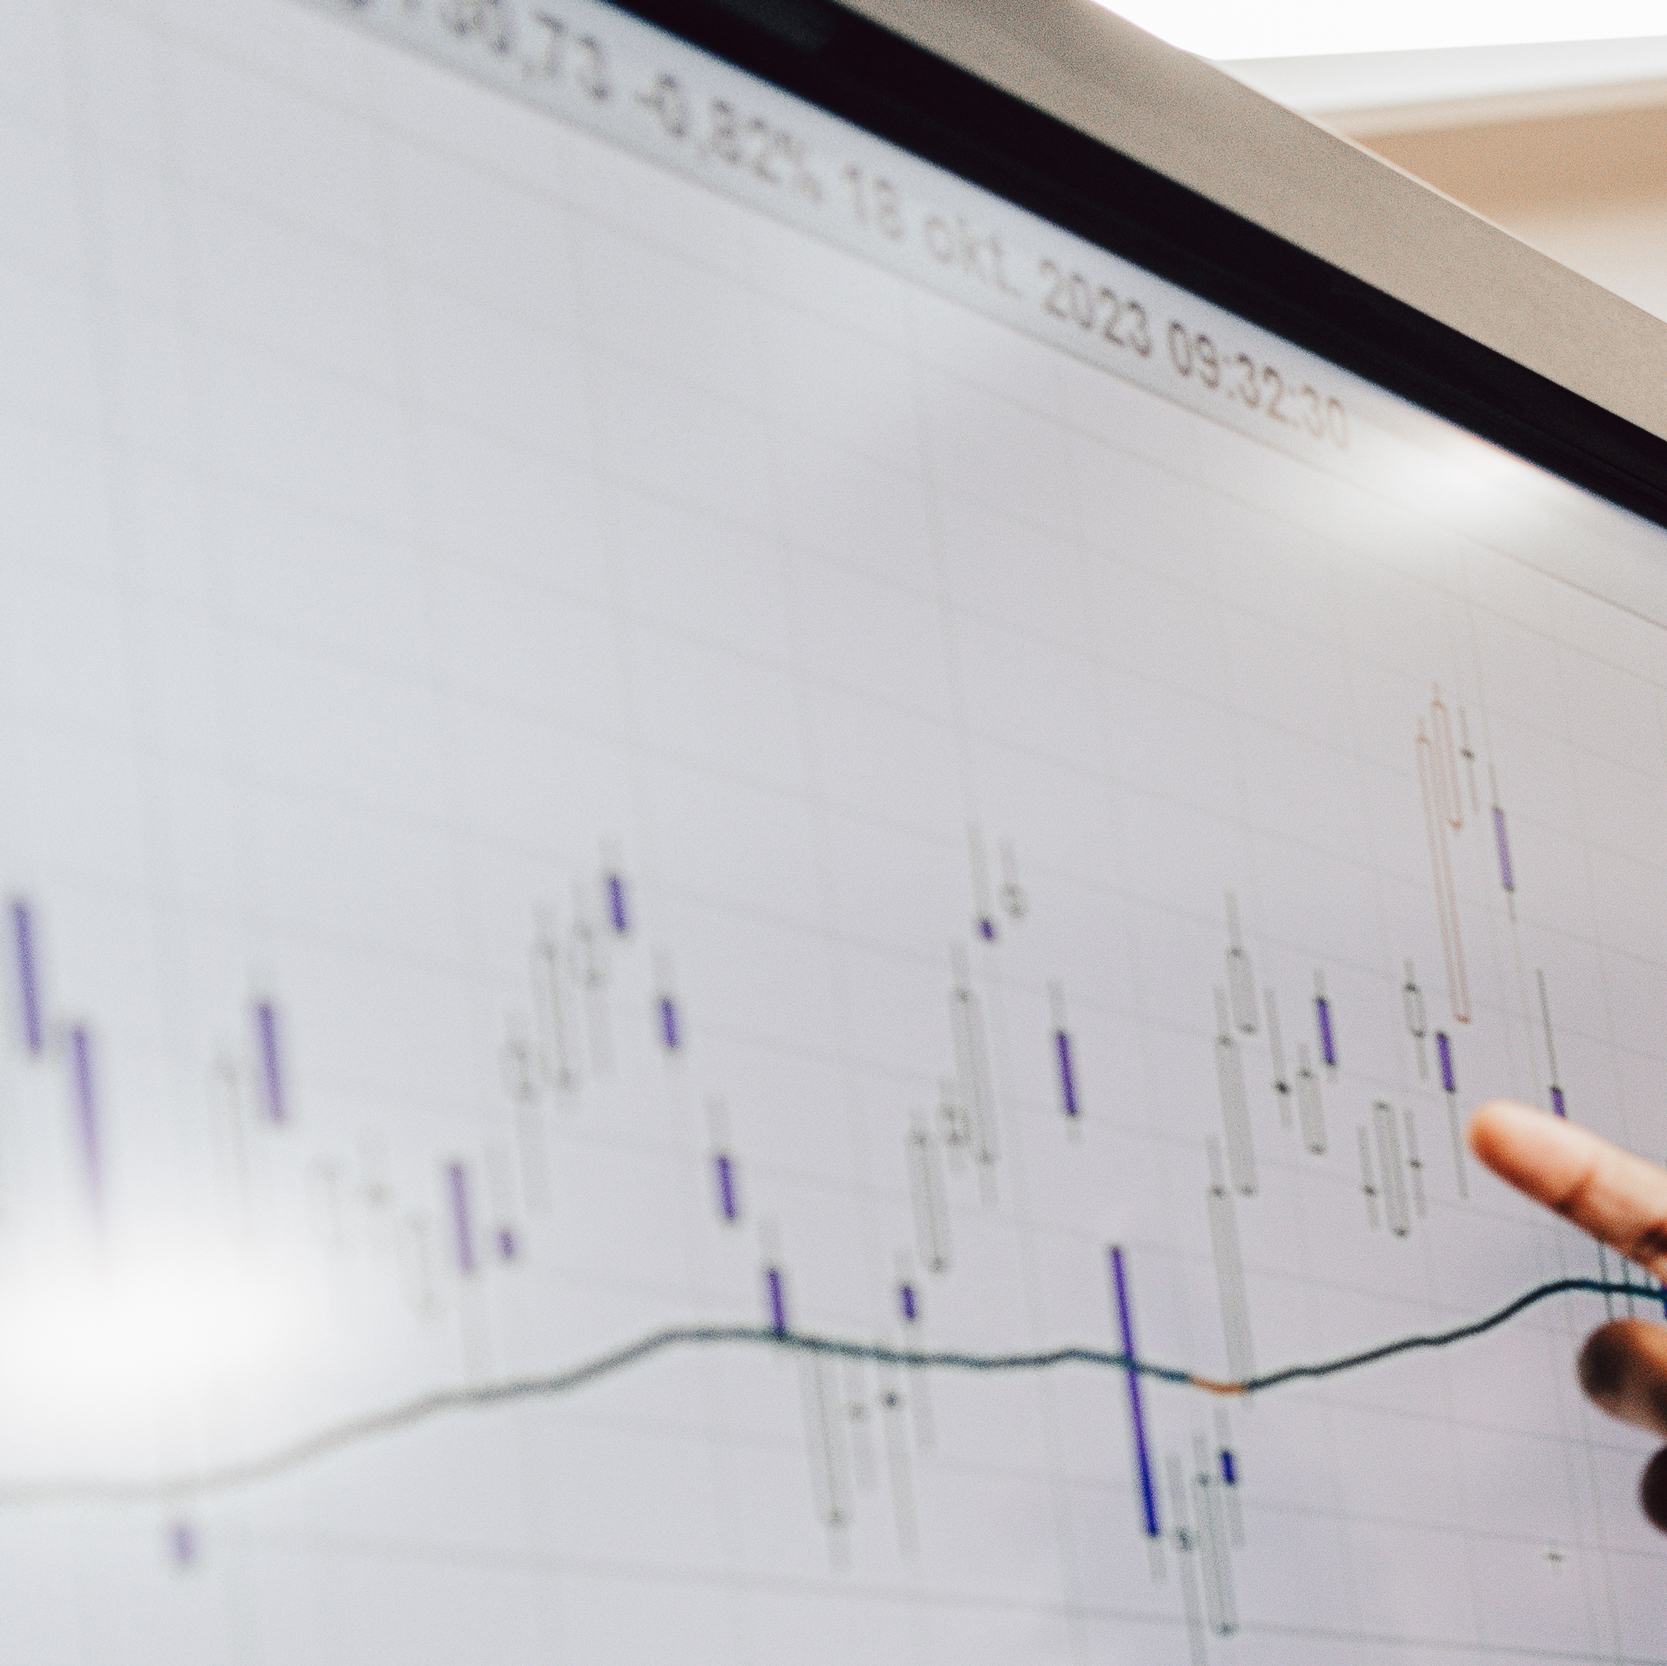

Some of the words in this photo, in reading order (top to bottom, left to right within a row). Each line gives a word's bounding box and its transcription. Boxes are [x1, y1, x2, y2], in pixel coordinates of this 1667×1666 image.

[634, 66, 827, 206] -0,82%
[840, 163, 905, 243] 18
[1037, 255, 1153, 360] 2023
[1166, 318, 1351, 449] 09:32:30
